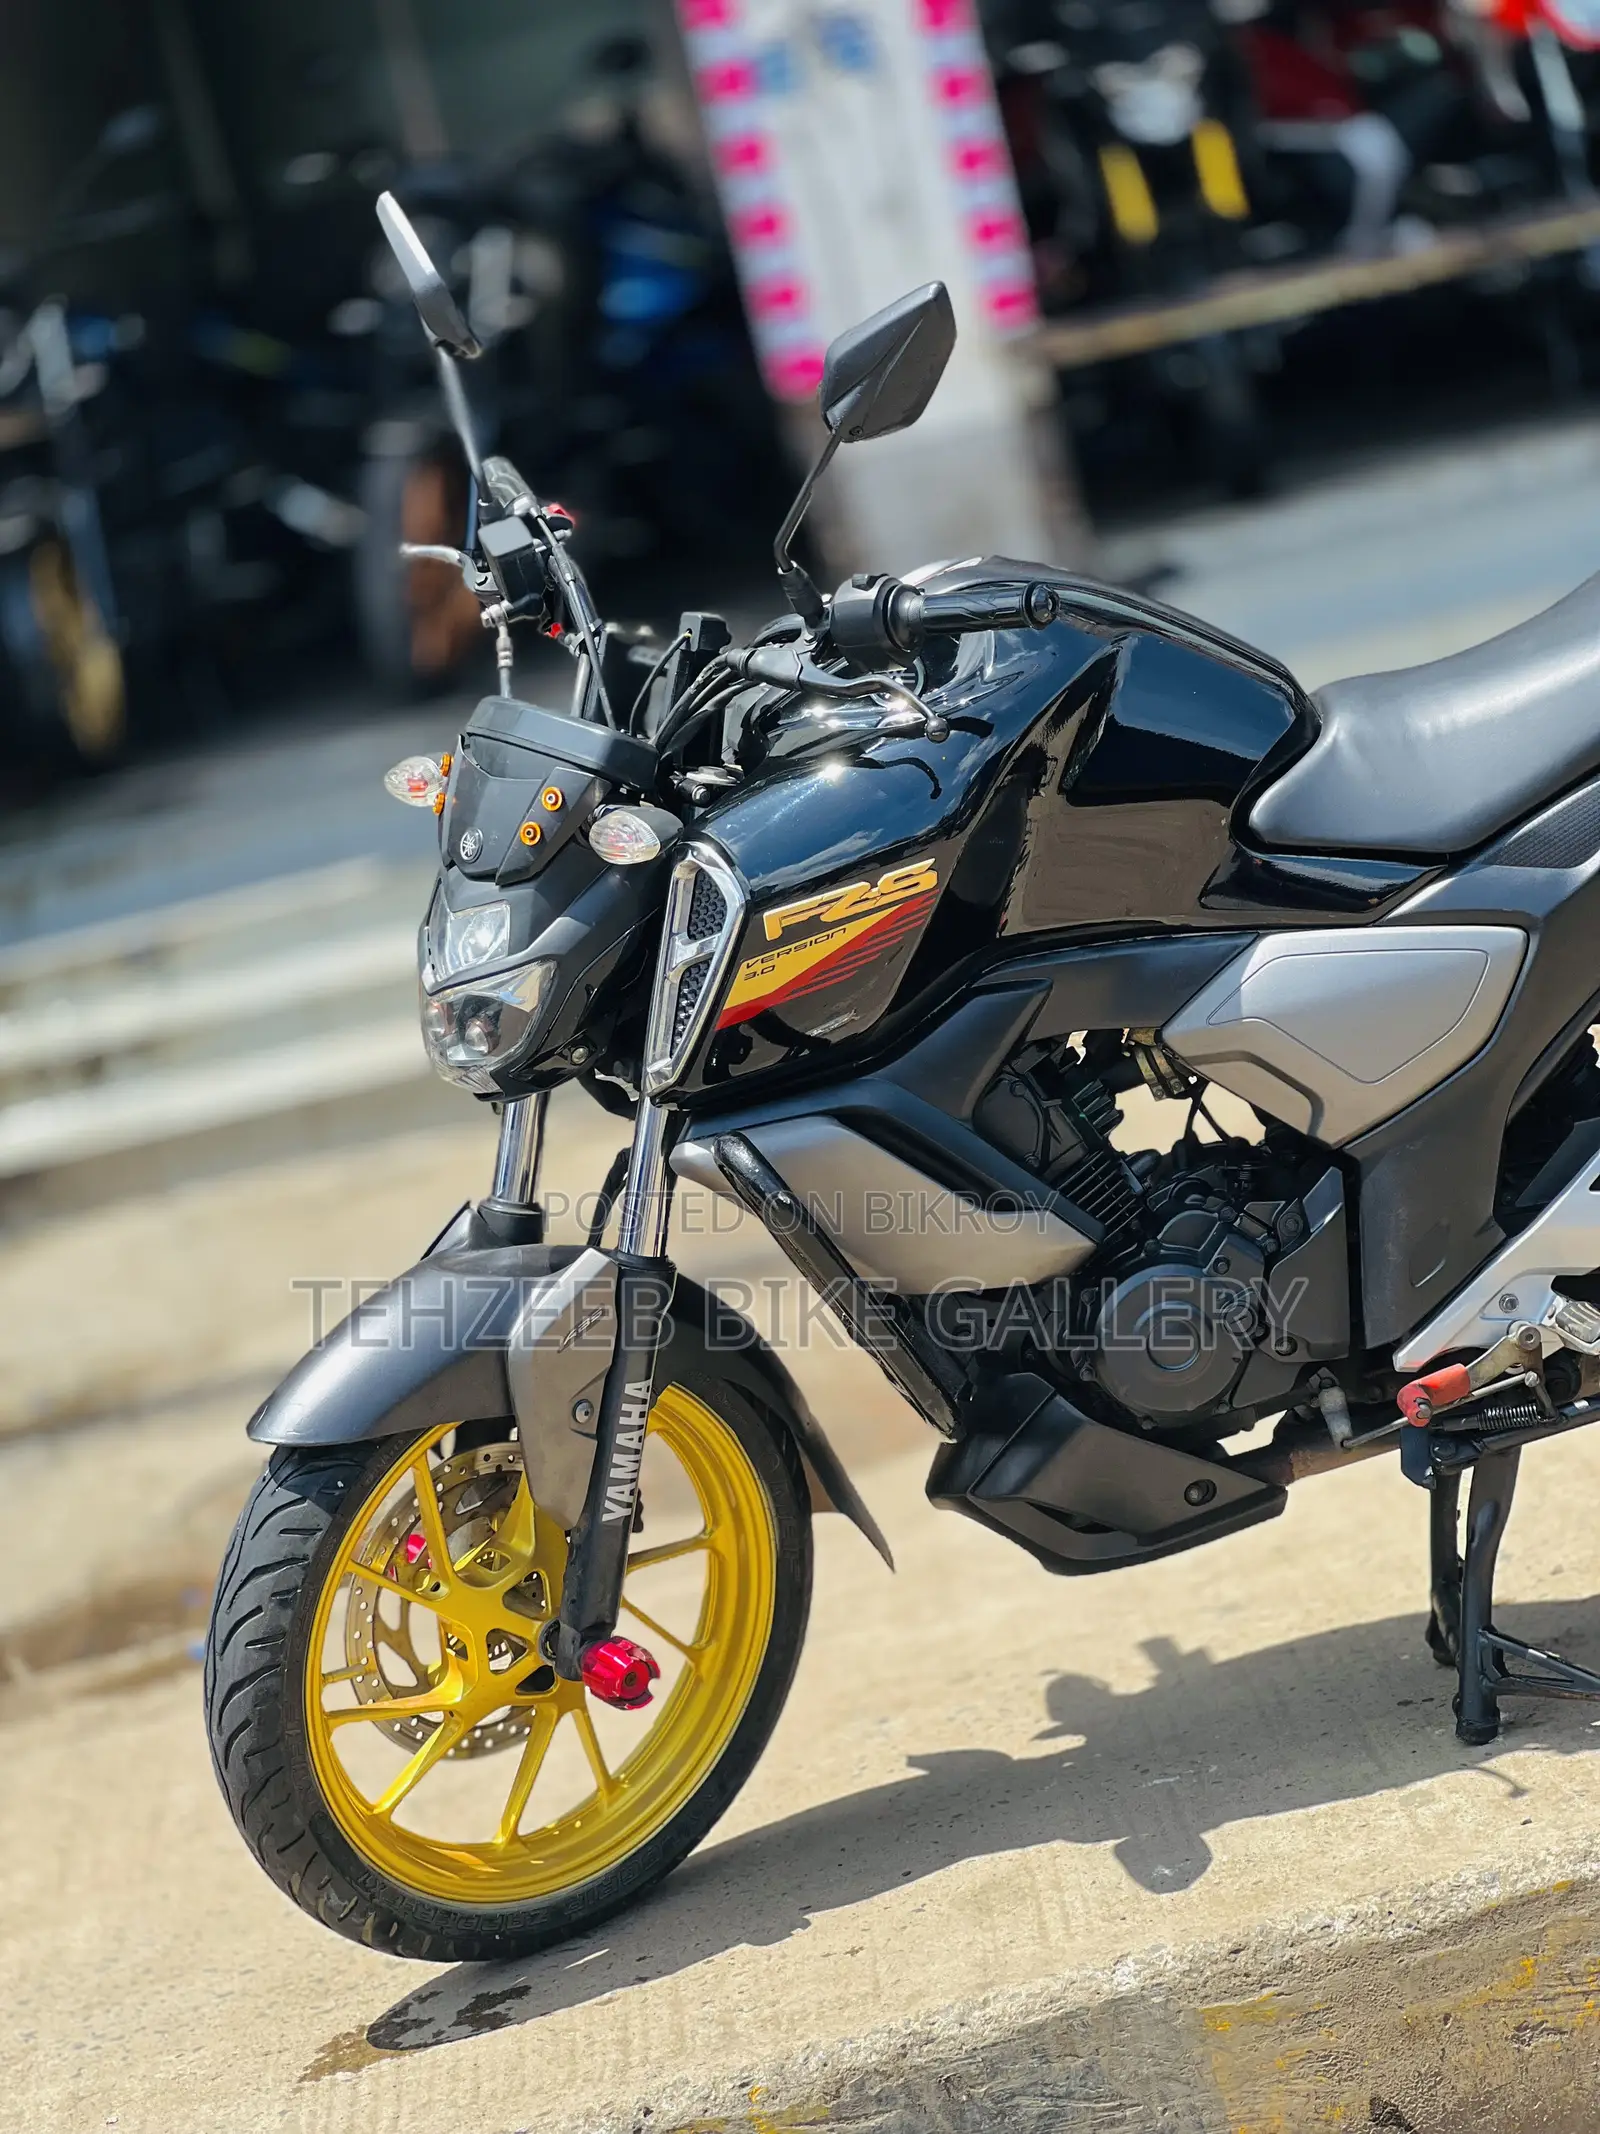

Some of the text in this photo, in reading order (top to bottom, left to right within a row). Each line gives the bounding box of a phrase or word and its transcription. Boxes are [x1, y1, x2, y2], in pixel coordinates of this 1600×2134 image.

[745, 927, 846, 969] VERSION
[743, 964, 776, 981] 3.0
[602, 1378, 652, 1522] YAMAHA
